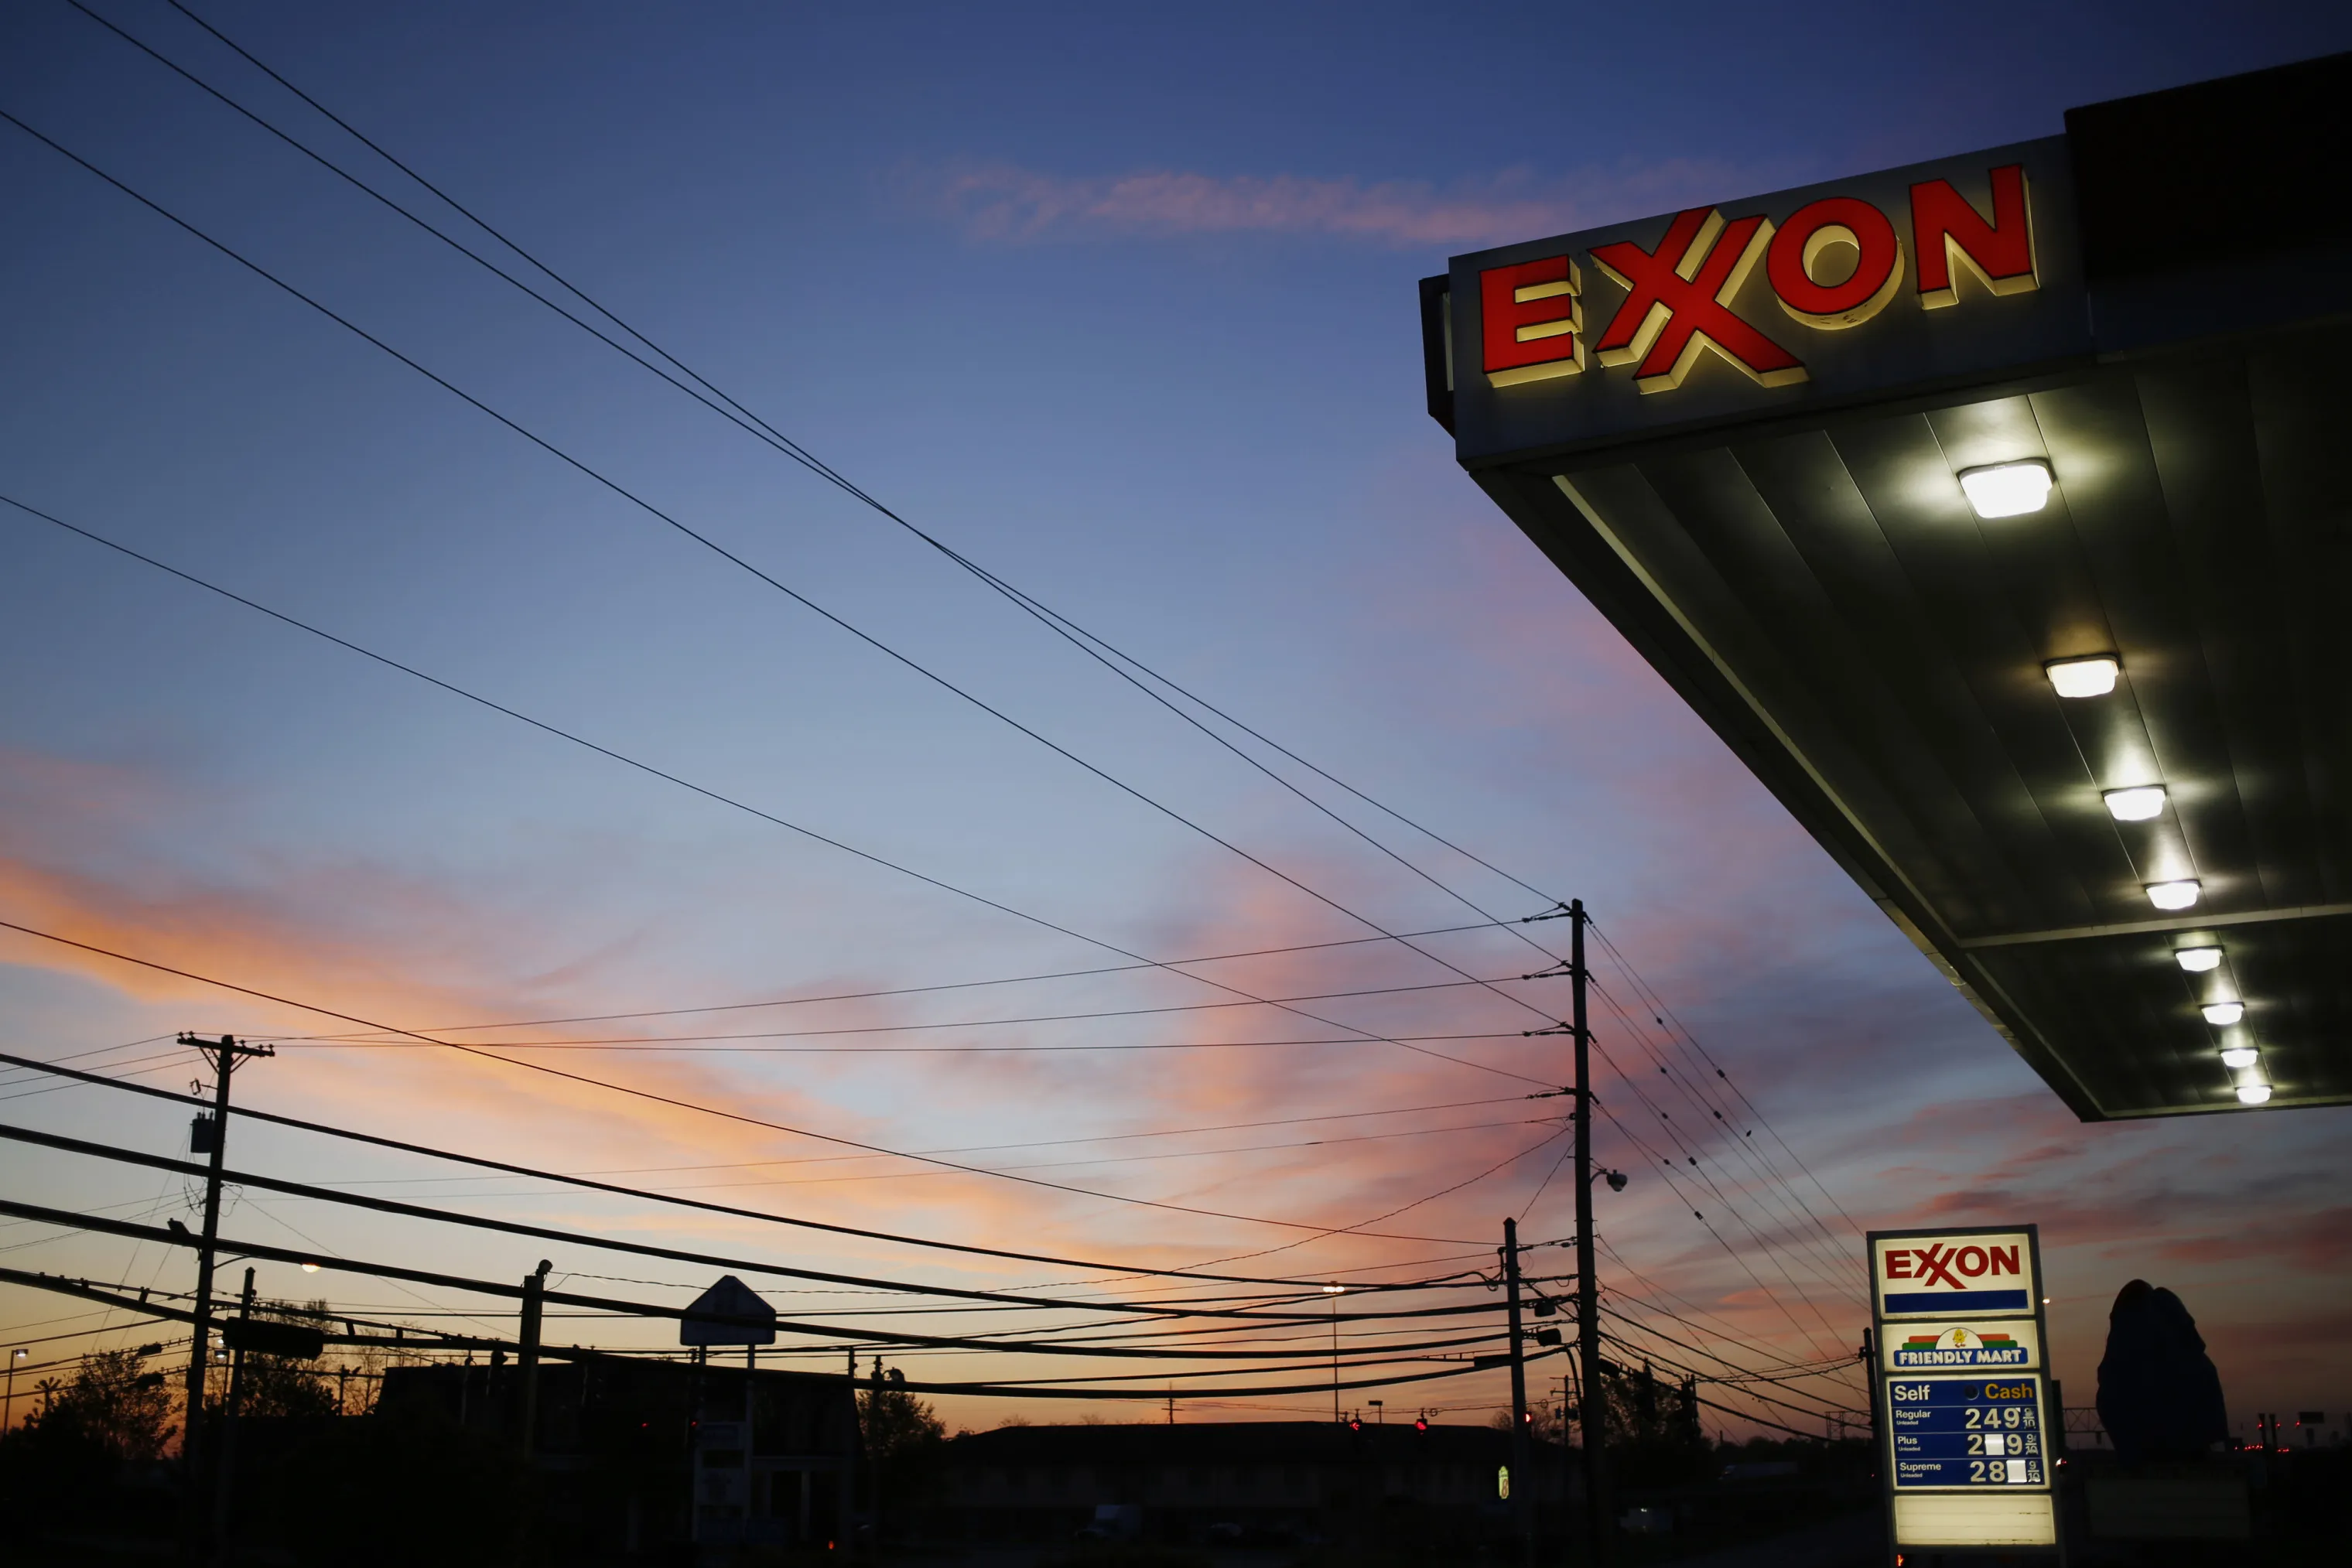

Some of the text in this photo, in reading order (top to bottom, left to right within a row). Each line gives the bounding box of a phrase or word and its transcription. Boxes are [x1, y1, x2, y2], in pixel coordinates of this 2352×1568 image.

[1479, 163, 2039, 394] EXXON
[1885, 1243, 2021, 1290] EXXON
[1899, 1349, 2022, 1365] FRIENDLY MART
[1894, 1383, 2033, 1402] Self Cash
[1896, 1407, 2020, 1430] Regular 249
[1898, 1433, 2023, 1455] Plus 29
[1899, 1460, 2026, 1483] Supreme 28
